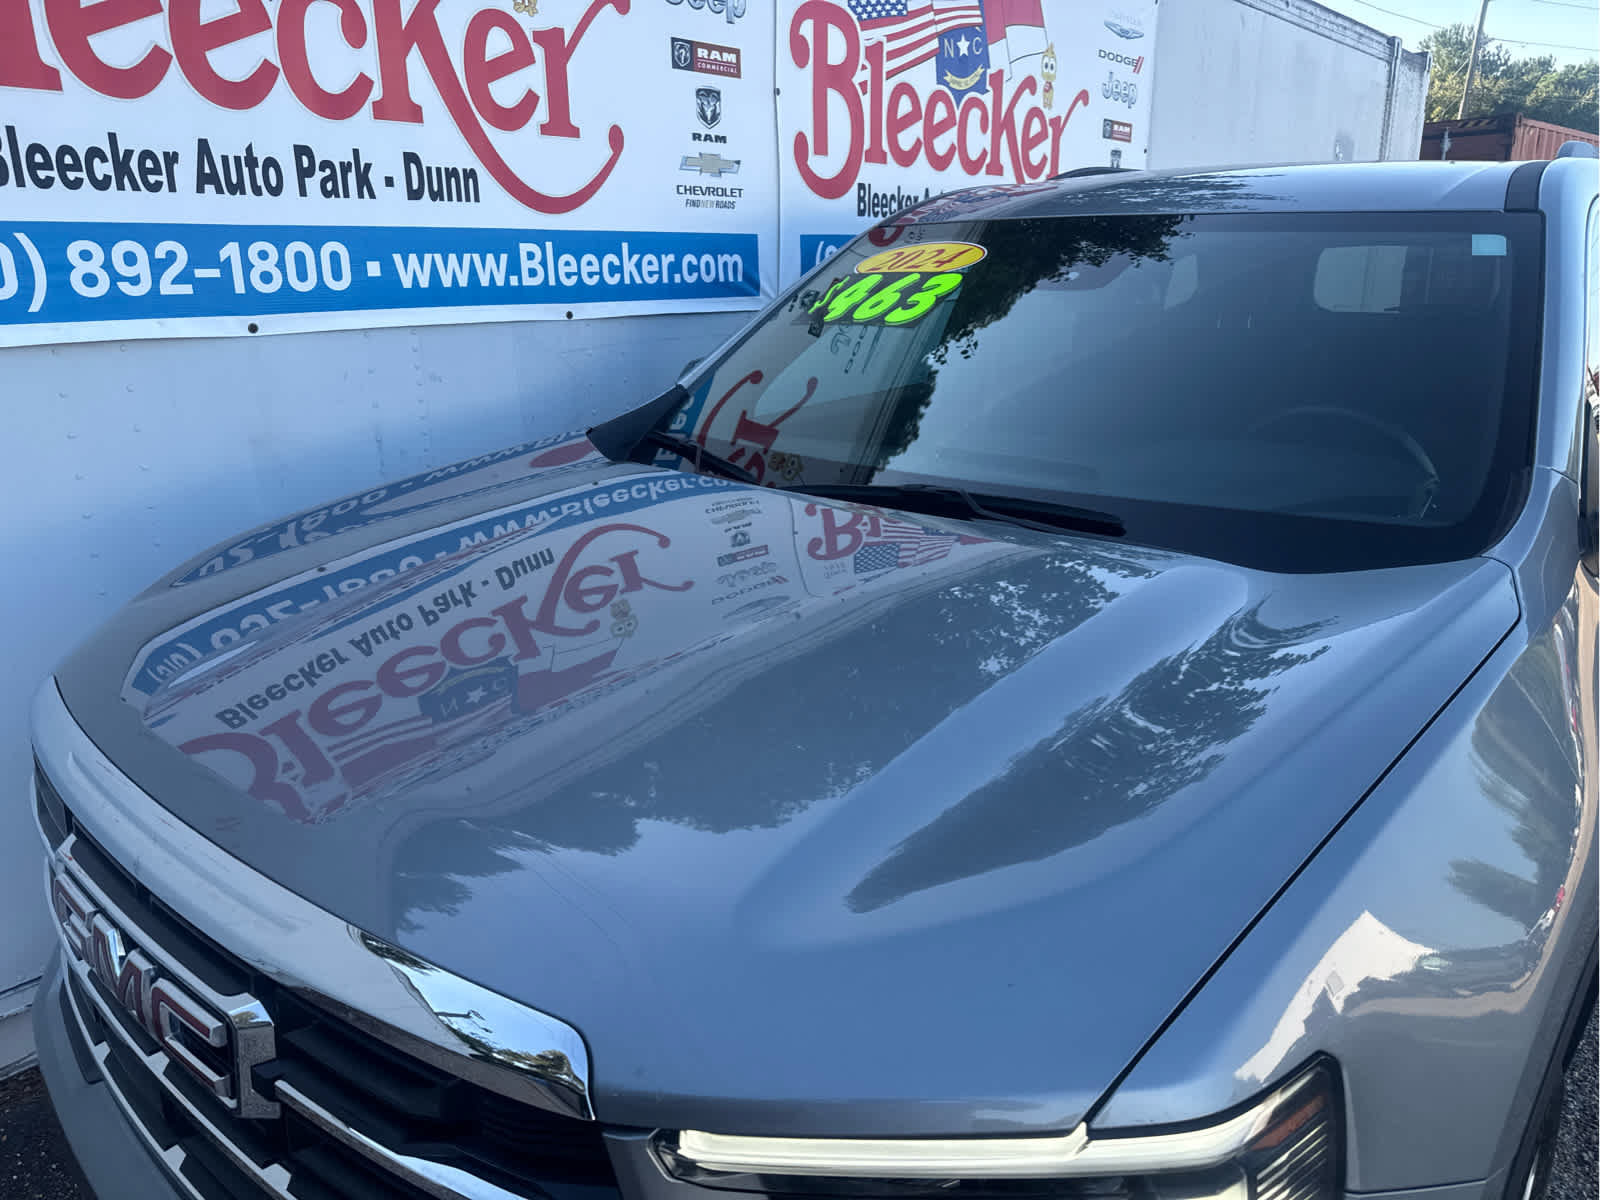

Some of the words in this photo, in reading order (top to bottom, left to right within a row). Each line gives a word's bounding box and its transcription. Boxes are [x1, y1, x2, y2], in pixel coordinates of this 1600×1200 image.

[697, 47, 737, 63] RAM
[697, 62, 738, 73] COMMERCIAL
[1098, 49, 1138, 68] DODGE
[789, 0, 1089, 199] Bleecker
[1102, 71, 1137, 109] Jeep
[692, 132, 727, 144] RAM
[0, 124, 179, 193] leecker
[196, 138, 284, 197] Auto
[293, 144, 377, 200] Park
[403, 151, 481, 203] Dunn
[676, 184, 743, 198] CHEVROLET
[66, 239, 352, 298] 892-1800
[392, 241, 744, 289] www.Bleecker.com
[865, 247, 978, 272] 2024
[808, 273, 964, 325] $463
